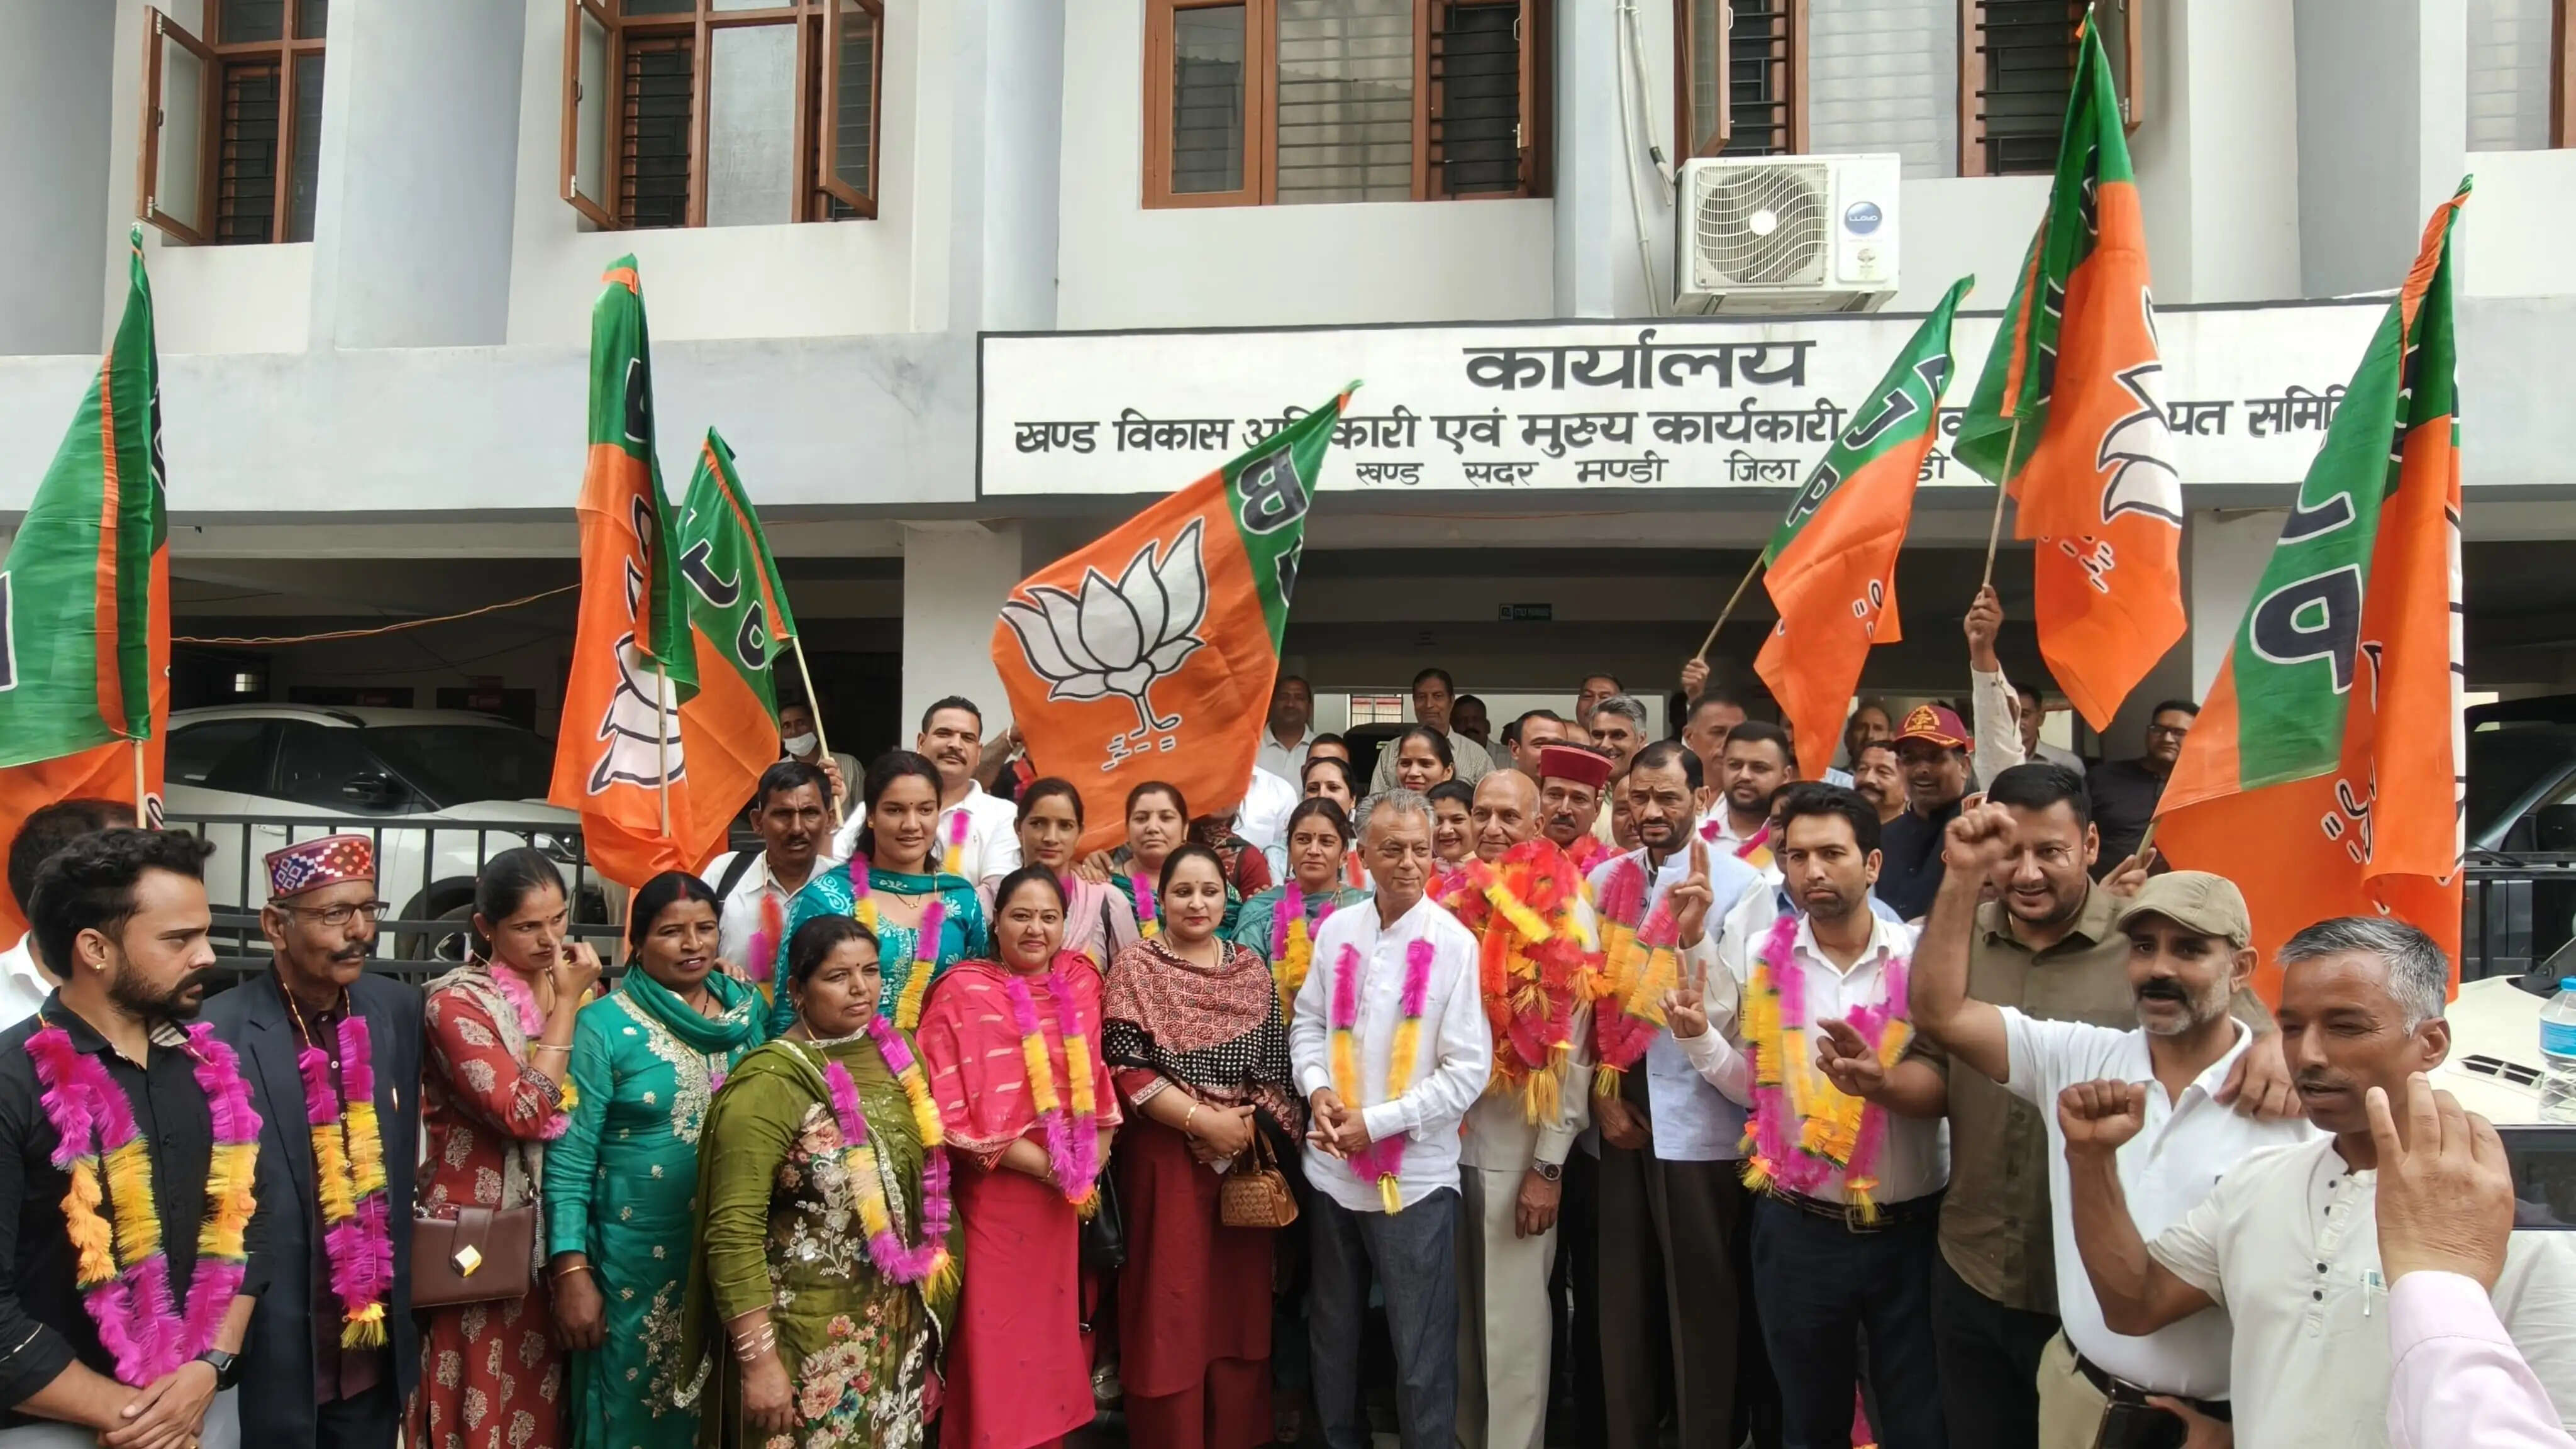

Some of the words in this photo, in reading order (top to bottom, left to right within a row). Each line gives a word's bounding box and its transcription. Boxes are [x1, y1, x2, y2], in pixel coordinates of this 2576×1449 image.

[1463, 329, 1816, 390] कार्यालय
[1014, 421, 1100, 453] खण्ड
[1113, 408, 1235, 452] विकास
[1430, 406, 1507, 455] एवं
[1647, 397, 1847, 444] कार्यकारी
[1356, 462, 1424, 486] खण्ड
[1462, 462, 1540, 488] सदर
[1575, 450, 1669, 483] मण्डी
[1723, 449, 1801, 482] जिला
